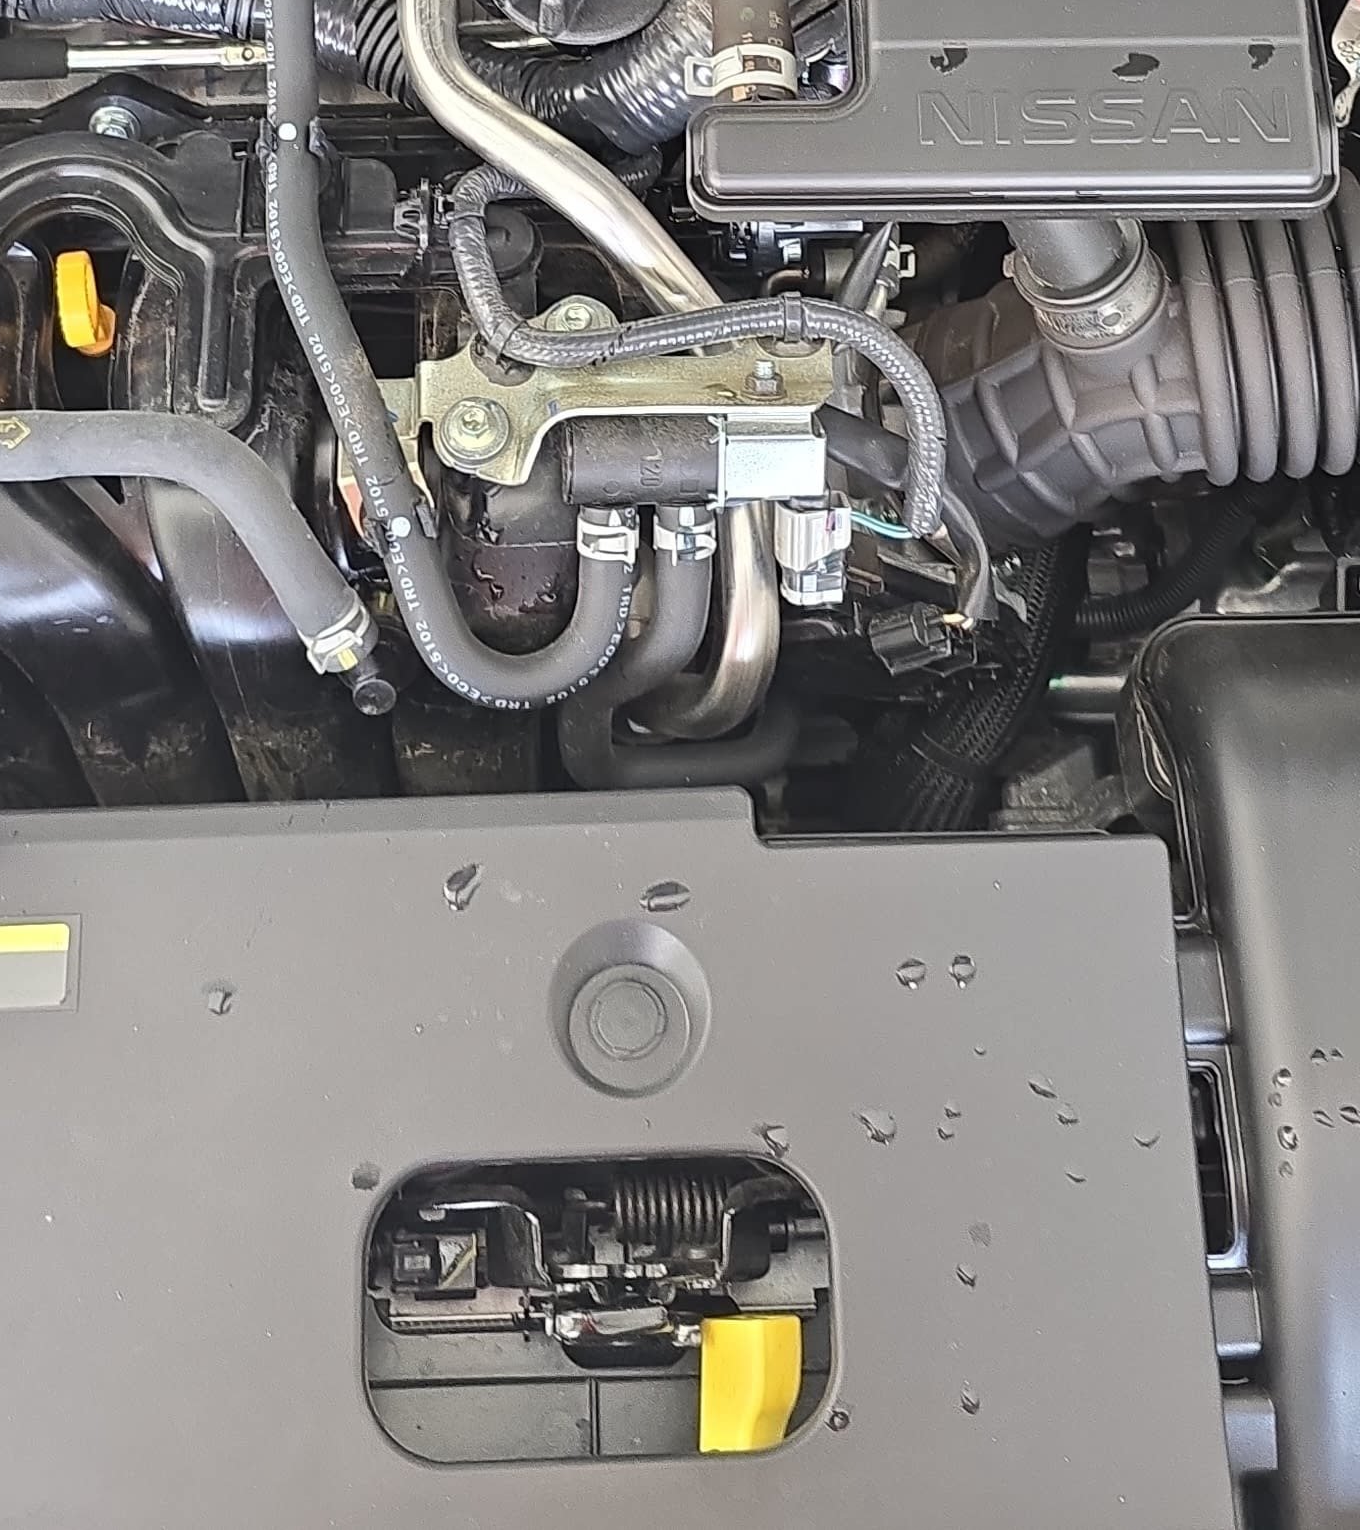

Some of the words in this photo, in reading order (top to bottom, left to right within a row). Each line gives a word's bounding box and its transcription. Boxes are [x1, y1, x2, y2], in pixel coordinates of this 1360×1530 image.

[917, 87, 1292, 145] NISSAN
[266, 199, 313, 326] TRD>ECO<5102
[306, 332, 371, 466] TRD>ECO<5102
